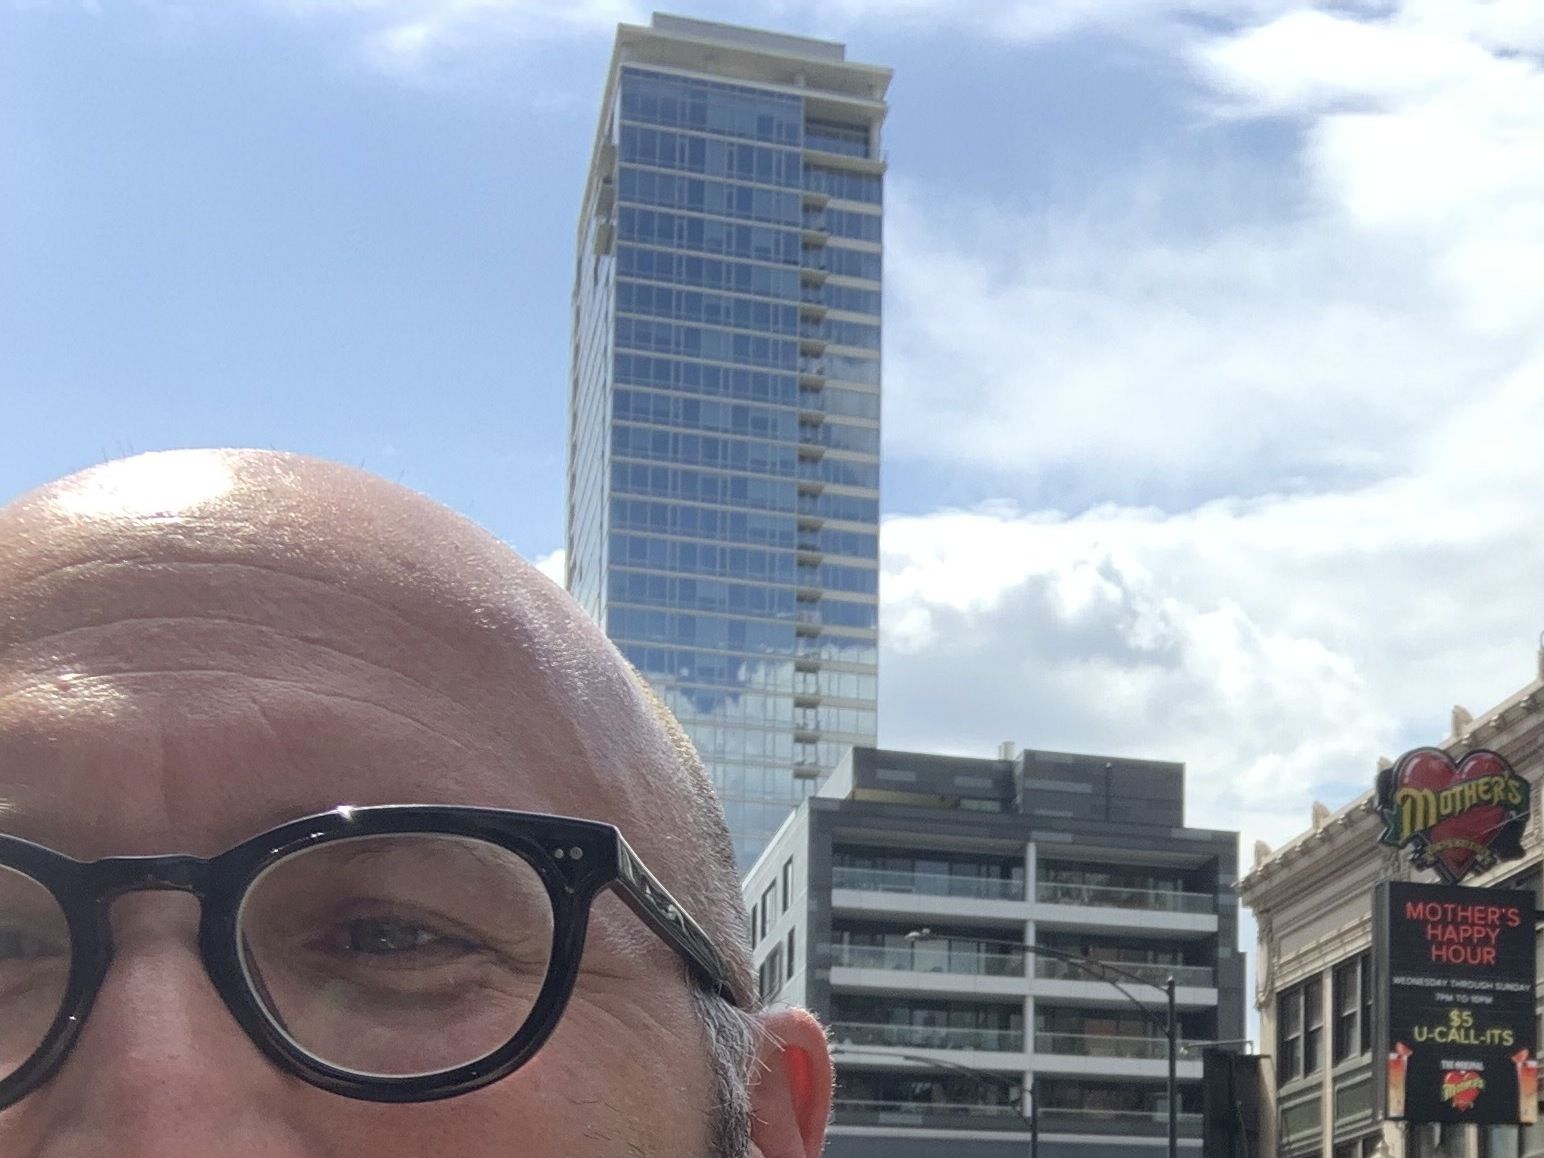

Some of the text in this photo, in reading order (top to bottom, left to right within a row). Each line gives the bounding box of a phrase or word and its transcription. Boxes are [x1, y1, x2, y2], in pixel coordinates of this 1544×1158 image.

[1405, 902, 1521, 928] MOTHER'S
[1426, 924, 1501, 945] HAPPY
[1431, 944, 1496, 966] HOUR
[1392, 976, 1531, 992] WEDNESDAY THROUGH SUNDAY
[1455, 994, 1469, 1003] TO
[1448, 1008, 1473, 1028] $5
[1413, 1025, 1515, 1046] U-CALL-ITS
